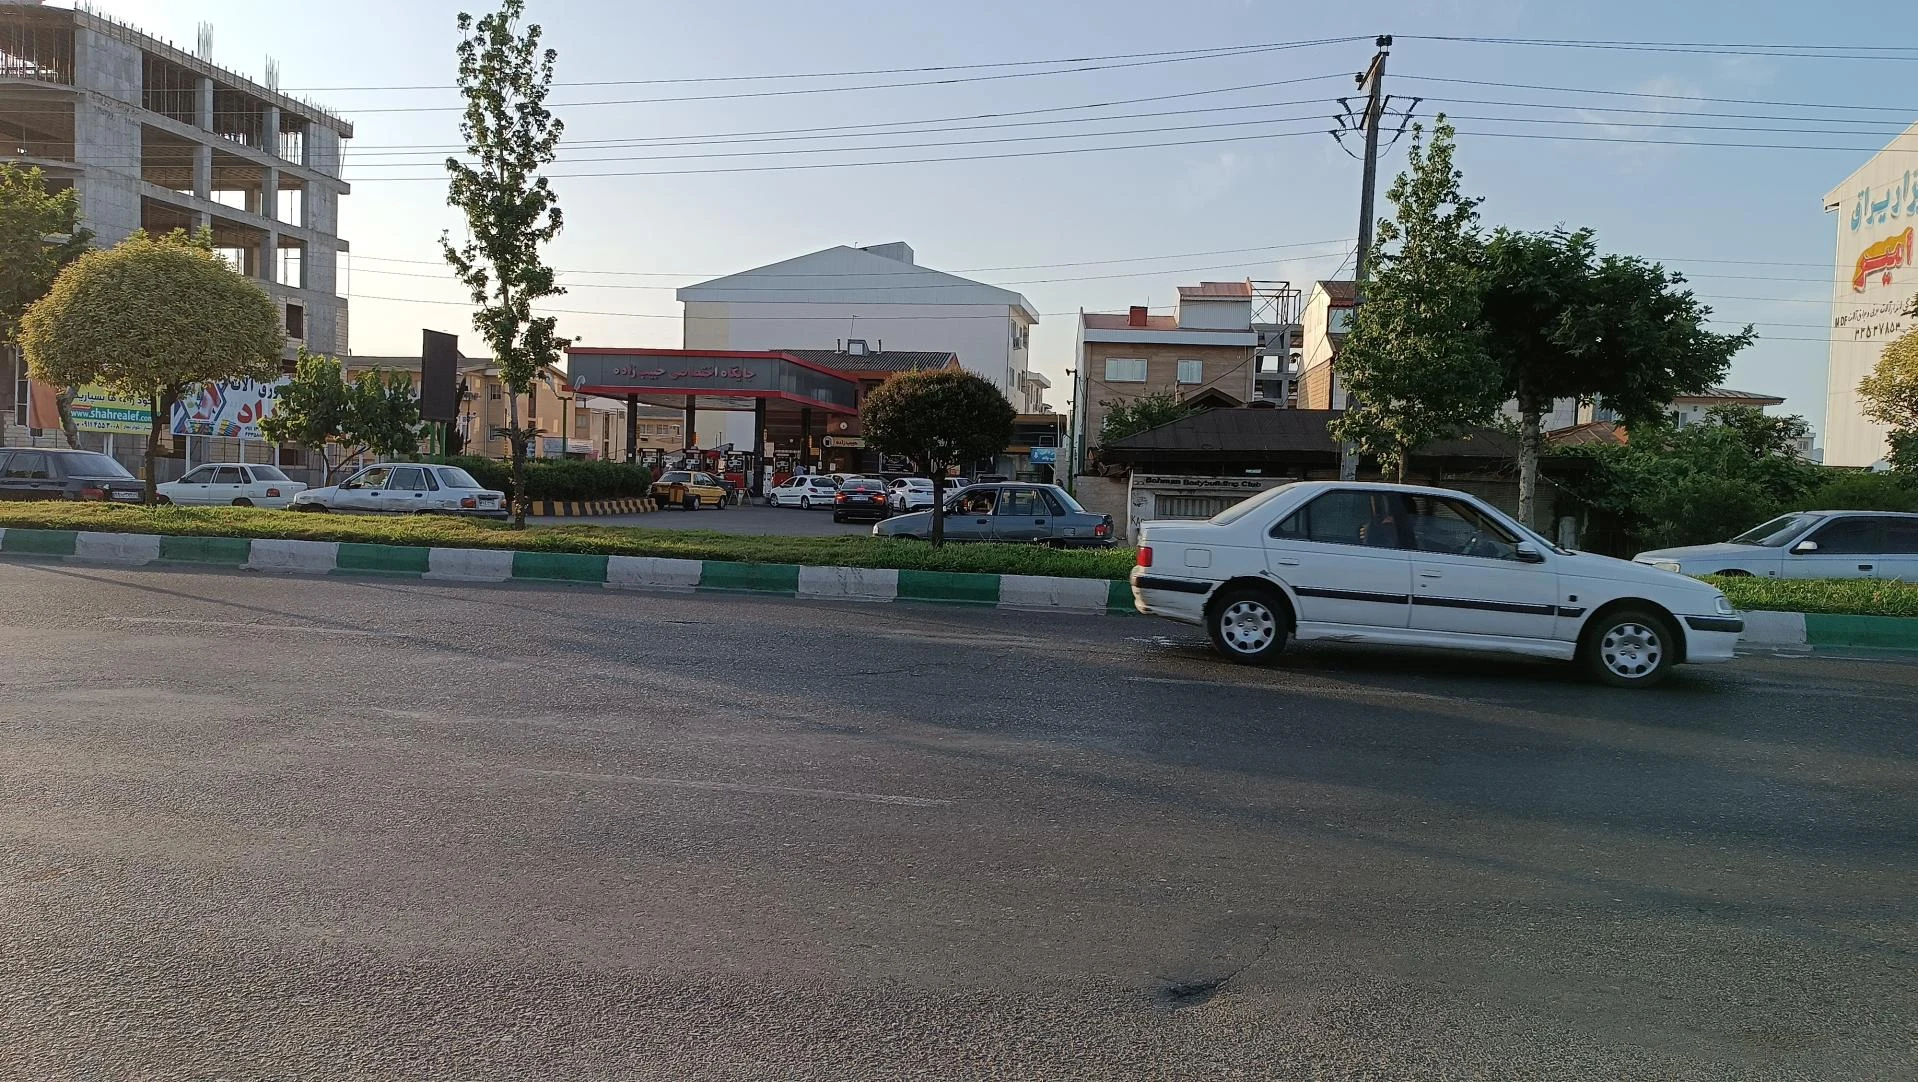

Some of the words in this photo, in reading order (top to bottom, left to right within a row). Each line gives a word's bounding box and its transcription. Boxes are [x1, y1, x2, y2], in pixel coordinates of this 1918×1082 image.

[1853, 228, 1914, 292] امیر
[613, 364, 637, 378] زاده
[640, 367, 666, 380] حبیب
[670, 366, 719, 380] اختصاصی
[720, 366, 756, 382] جایگاه
